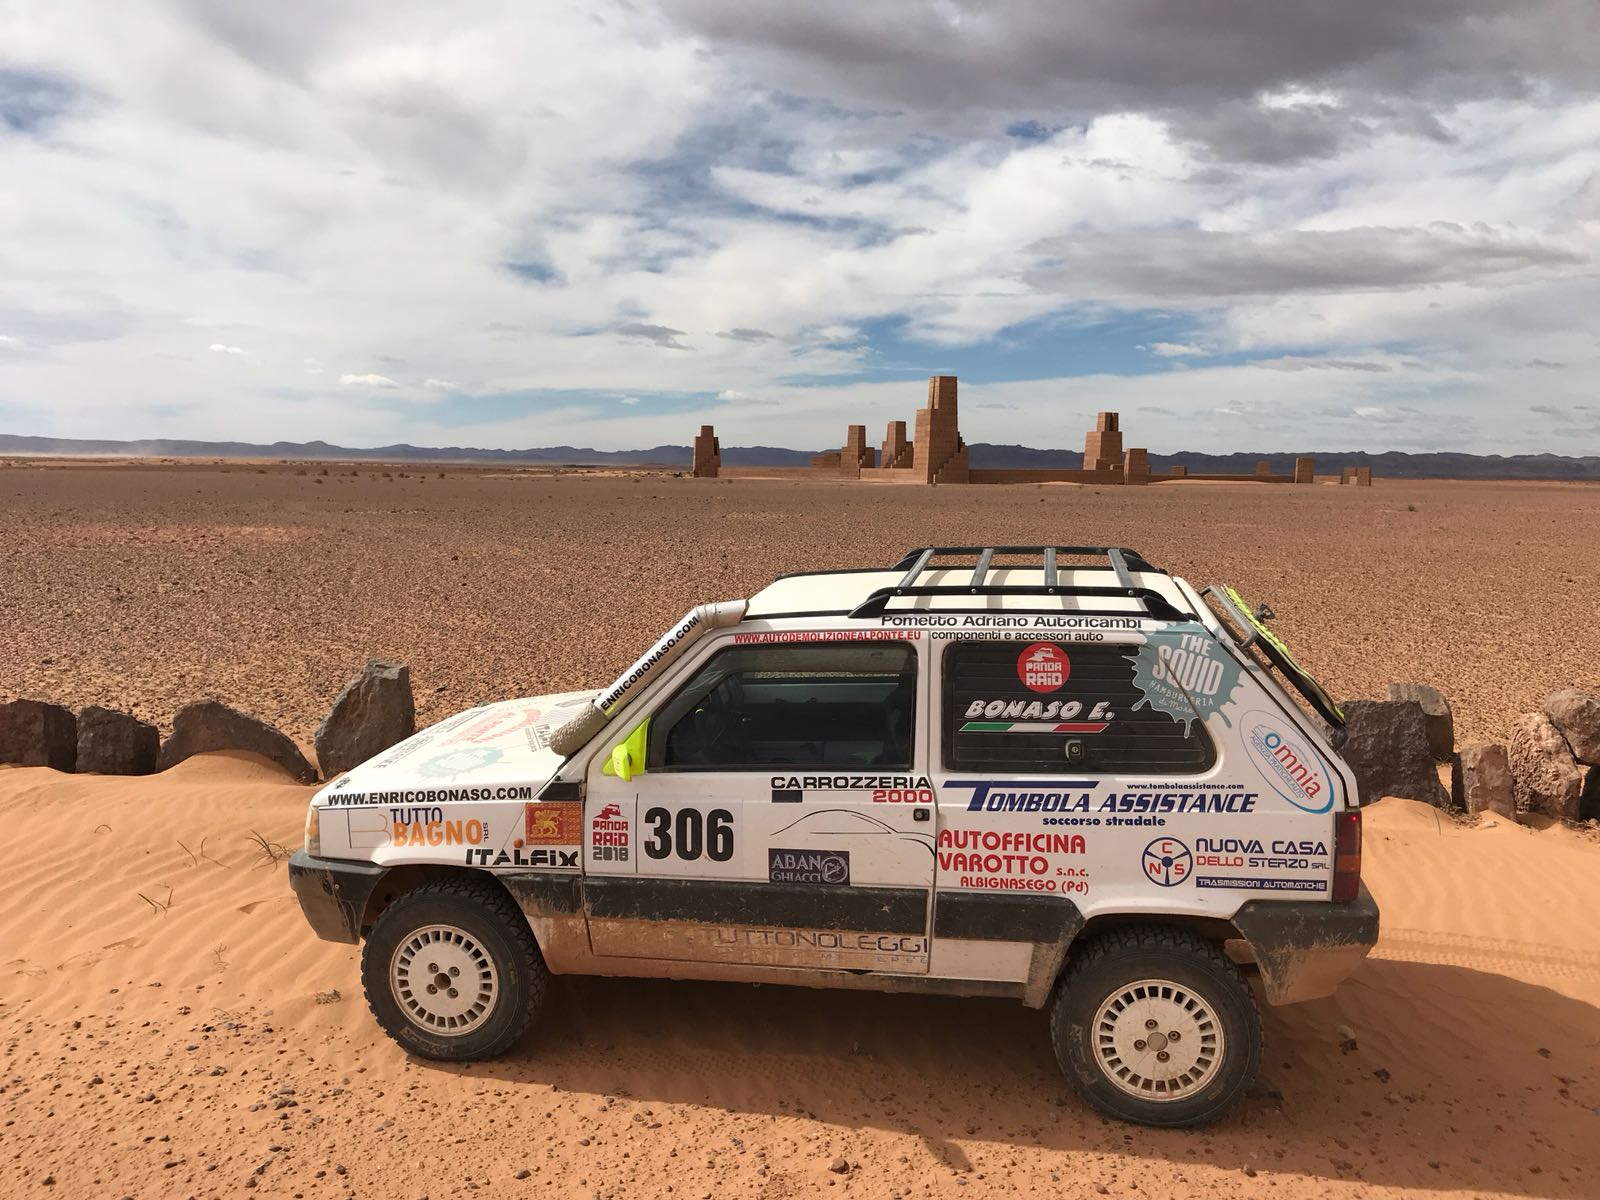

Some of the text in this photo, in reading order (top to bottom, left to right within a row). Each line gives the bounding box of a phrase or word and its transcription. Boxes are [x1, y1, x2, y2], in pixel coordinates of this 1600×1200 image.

[881, 616, 1141, 628] Pometto Adriano Autoricambi
[735, 631, 921, 643] WWW.AUTODEMOLIZIONEALPONTE.EU
[931, 631, 1104, 643] componenti e accessori auto
[1180, 634, 1213, 656] THE
[600, 616, 699, 711] ENRICOBONASO.COM
[1026, 662, 1061, 671] PANDA
[1152, 645, 1224, 695] SQUID
[964, 700, 1116, 720] BONASO E.
[1264, 732, 1321, 798] omnia
[771, 776, 931, 789] CARROZZERIA
[328, 787, 532, 806] WWW.ENRICOBONASO.COM
[872, 790, 933, 803] 2000
[1098, 793, 1258, 813] ASSISTANCE
[390, 807, 443, 826] TUTTO
[593, 820, 628, 830] PANDA
[1043, 815, 1166, 826] soccorso stradale
[393, 819, 483, 847] BAGNO
[644, 807, 734, 862] 306
[938, 829, 1086, 854] AUTOFFICINA
[593, 847, 628, 861] 2018
[1272, 840, 1328, 855] CASA
[938, 852, 1089, 877] VAROTTO s.n.c.
[1196, 855, 1330, 870] DELLO STERZO SRL
[771, 871, 822, 883] GHIACCI
[960, 875, 1089, 896] ALBIGNASEGO (Pd)
[1199, 878, 1326, 890] TRASMISSIONI AUTOMATICHE
